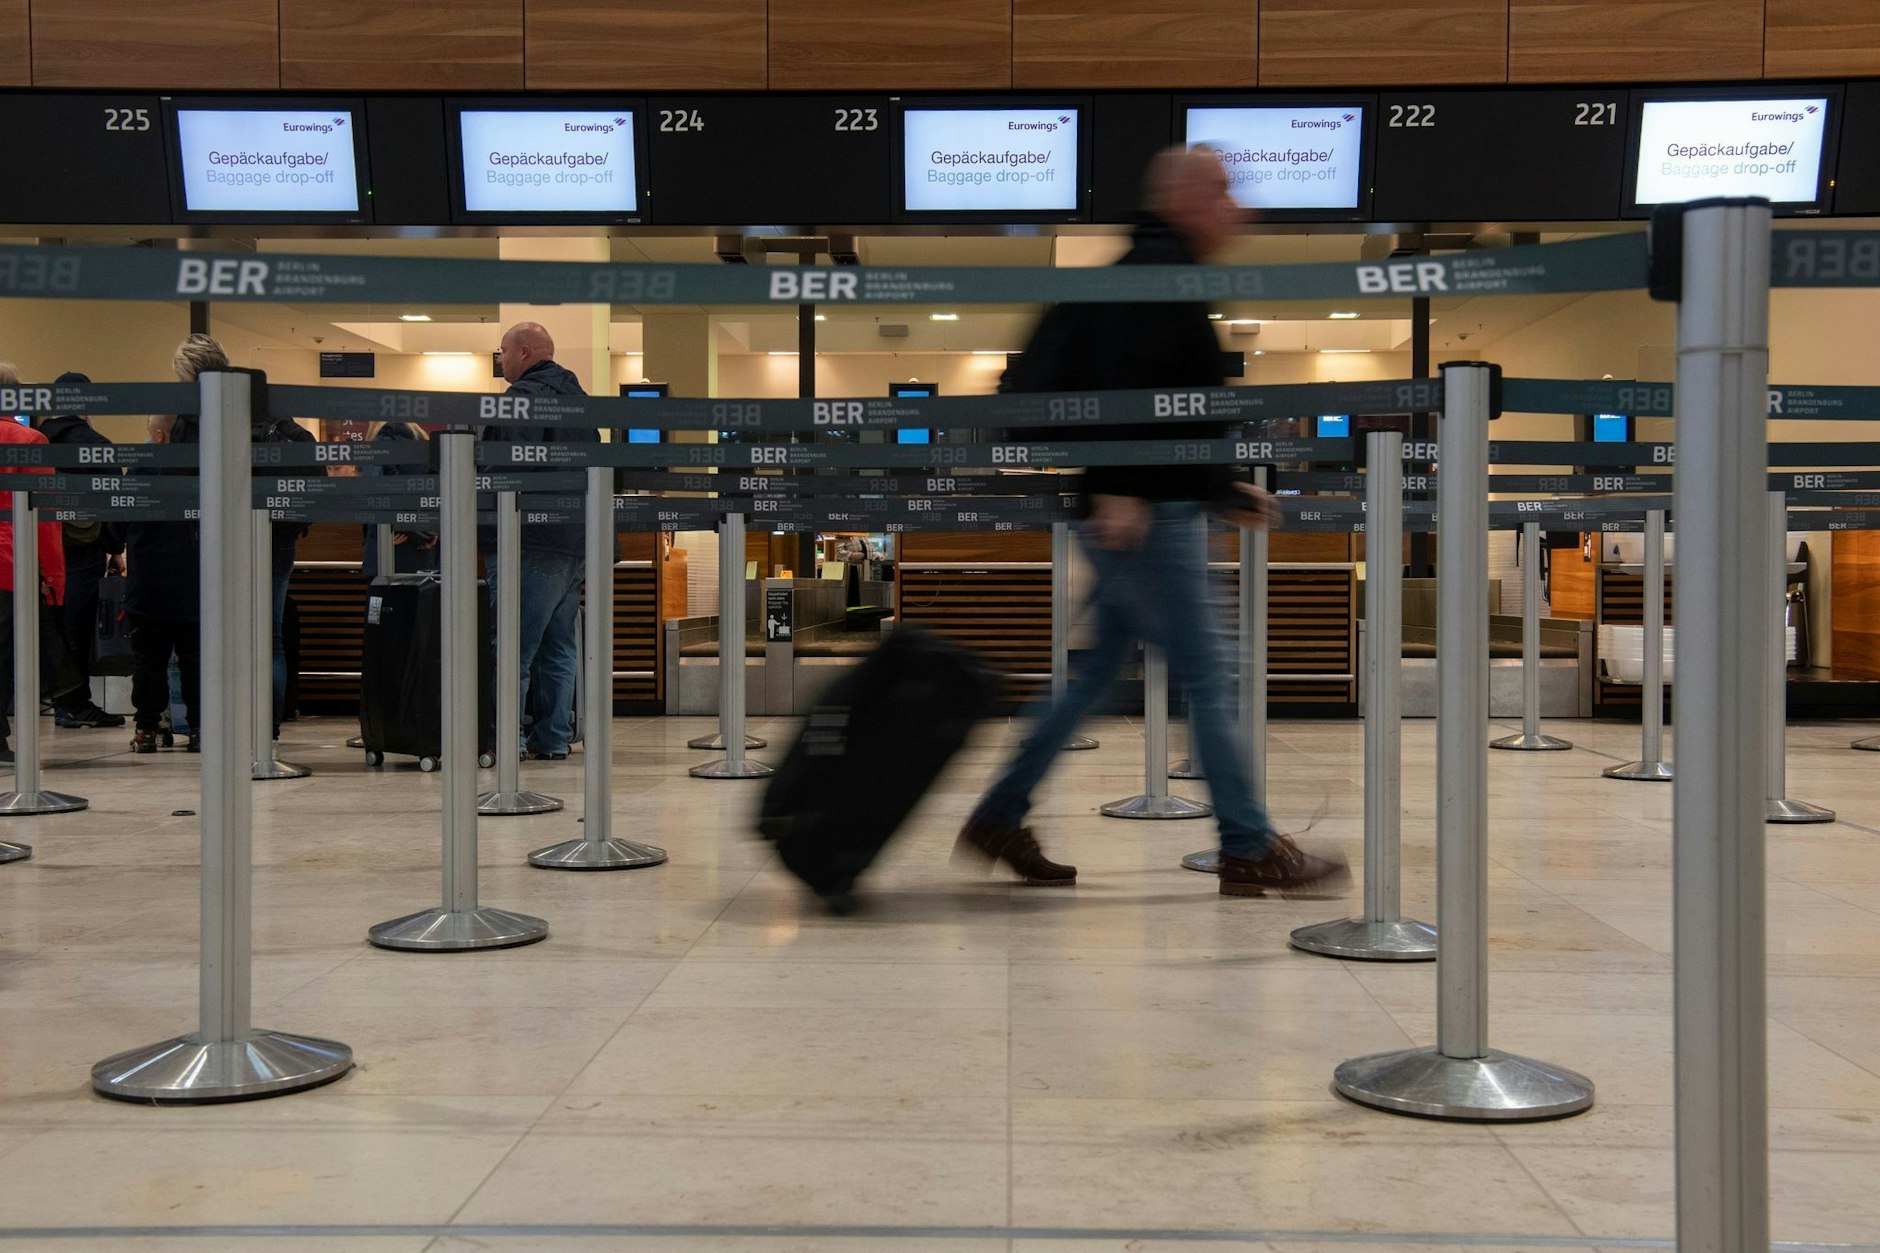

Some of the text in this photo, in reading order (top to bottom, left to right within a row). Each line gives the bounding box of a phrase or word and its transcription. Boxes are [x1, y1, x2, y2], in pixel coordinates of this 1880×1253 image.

[105, 109, 149, 130] 225
[660, 110, 704, 131] 224
[835, 109, 877, 130] 223
[1390, 105, 1435, 127] 222
[1575, 103, 1616, 125] 221
[1752, 113, 1804, 122] Eurowings
[284, 123, 333, 133] Eurowings
[565, 123, 614, 133] Eurowings
[1009, 122, 1058, 132] Eurowings
[1292, 120, 1342, 130] Eurowings
[1668, 141, 1796, 159] Gepäckaufgabe/
[209, 152, 328, 167] Gepäckaufgabe/
[490, 151, 608, 168] Gepäckaufgabe/
[932, 151, 1051, 167] Gepäckaufgabe/
[1278, 167, 1337, 183] drop-off
[1662, 159, 1796, 178] Baggage drop-off
[207, 169, 334, 186] Baggage drop-off
[487, 170, 613, 186] Baggage drop-off
[928, 169, 1055, 185] Baggage drop-off
[177, 260, 268, 294] BER
[1357, 263, 1447, 292] BER
[770, 272, 857, 299] BER
[1, 389, 51, 410] BER
[1155, 393, 1206, 416] BER
[480, 396, 529, 418] BER
[814, 402, 863, 424] BER
[79, 447, 114, 463] BER
[316, 445, 350, 460] BER
[512, 446, 547, 461] BER
[751, 448, 786, 463] BER
[992, 447, 1028, 462] BER
[1236, 443, 1272, 458] BER
[1402, 444, 1438, 459] BER
[1653, 446, 1675, 462] BE
[92, 478, 120, 490] BER
[278, 480, 305, 492] BER
[476, 477, 490, 489] ER
[740, 477, 768, 490] BER
[927, 479, 955, 491] BER
[1594, 477, 1623, 490] BER
[1794, 475, 1824, 488] BER
[111, 496, 135, 506] BER
[266, 497, 290, 507] BER
[754, 501, 778, 511] BER
[908, 500, 931, 510] BER
[1063, 497, 1078, 508] BE
[1517, 502, 1542, 511] BER
[56, 511, 75, 520] BER
[272, 510, 284, 519] ER
[397, 514, 416, 522] BER
[528, 514, 548, 522] BER
[659, 512, 678, 520] BER
[958, 513, 977, 521] BER
[1301, 512, 1320, 520] BER
[662, 523, 678, 531] BER
[777, 523, 794, 531] BER
[887, 524, 903, 532] BER
[1602, 523, 1619, 531] BER
